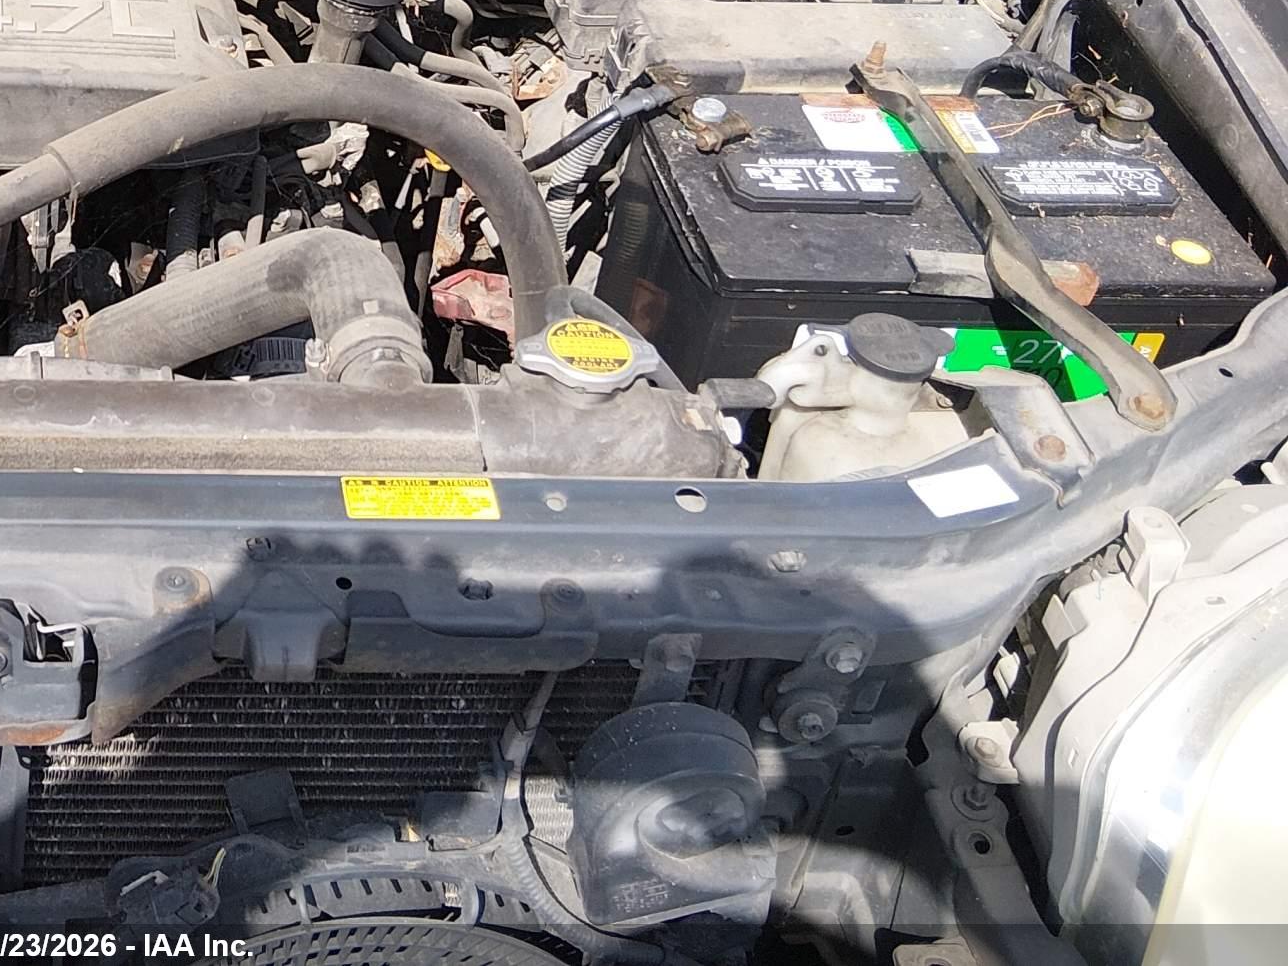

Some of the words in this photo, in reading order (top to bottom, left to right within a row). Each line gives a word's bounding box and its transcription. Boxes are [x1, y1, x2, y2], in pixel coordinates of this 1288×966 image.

[556, 329, 615, 339] CAUTION
[385, 479, 430, 487] CAUTION
[437, 479, 489, 488] ATTENTION
